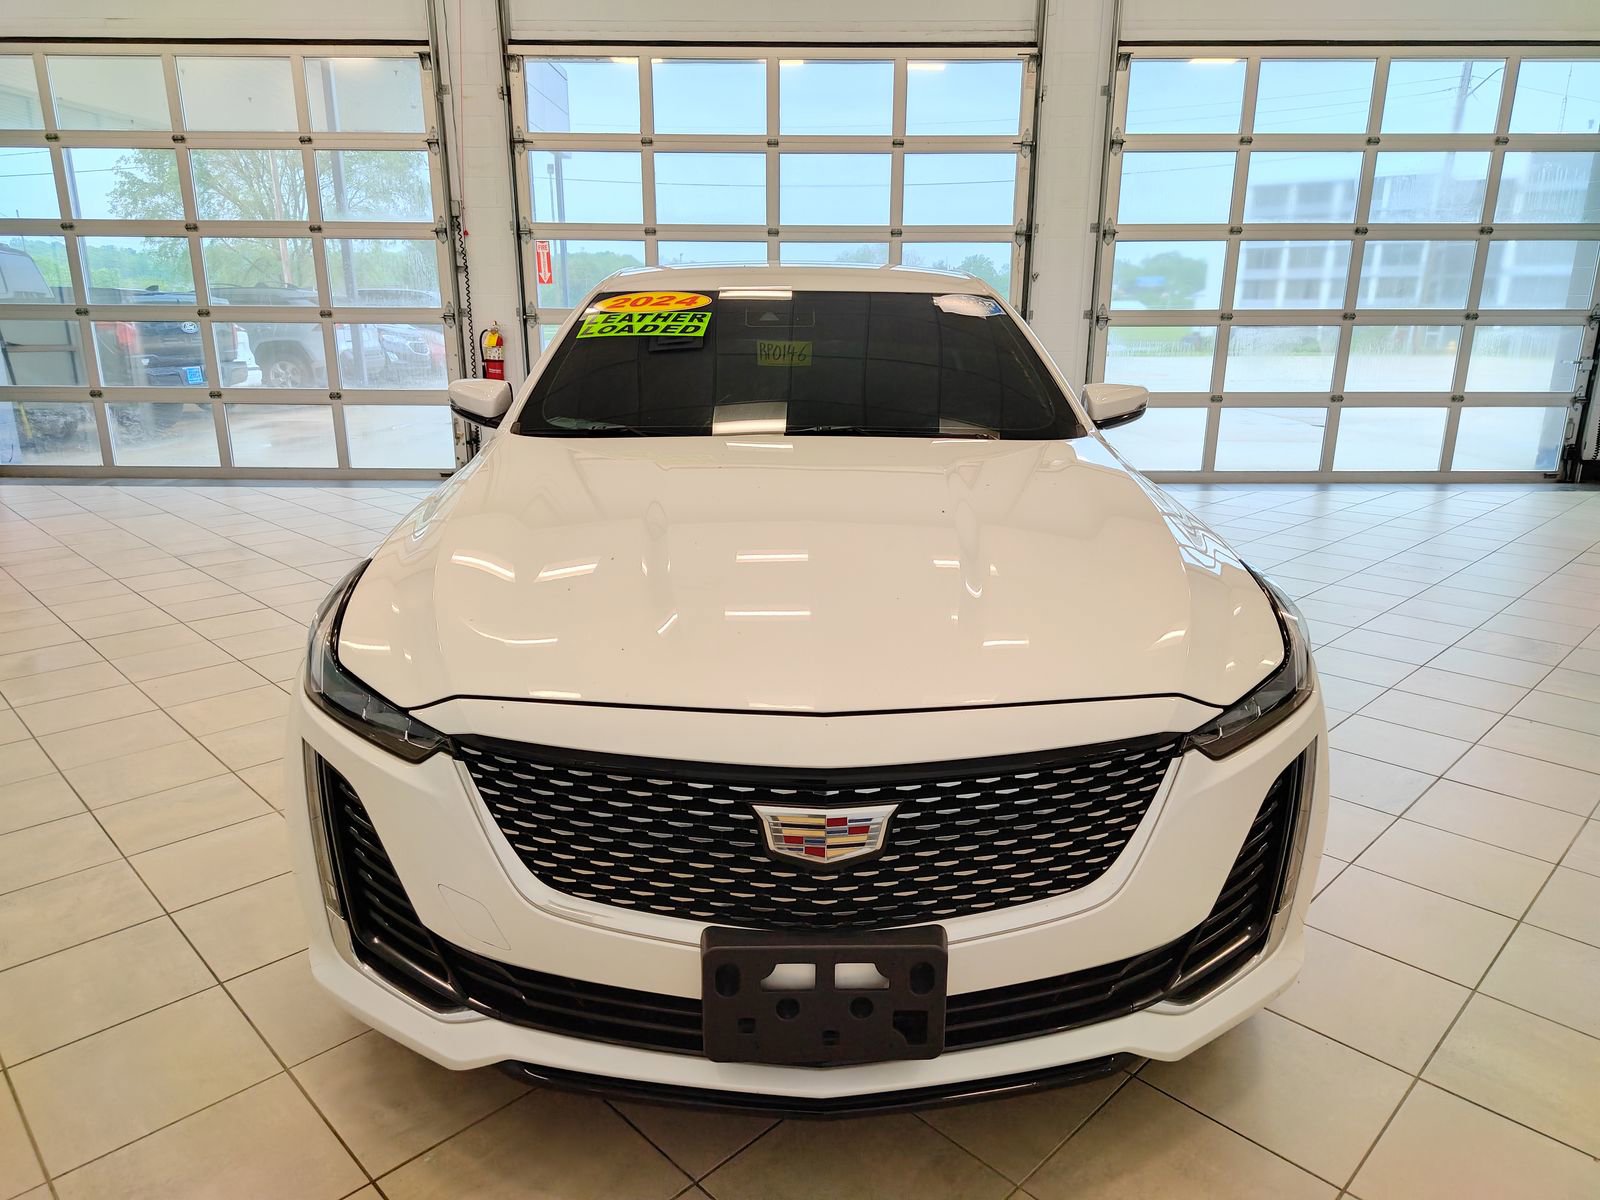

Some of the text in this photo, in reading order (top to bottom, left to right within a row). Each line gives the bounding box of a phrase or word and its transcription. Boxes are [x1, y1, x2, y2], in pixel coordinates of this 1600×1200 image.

[605, 295, 702, 310] 2024
[586, 312, 708, 325] LEATHER
[580, 324, 702, 336] LOADED
